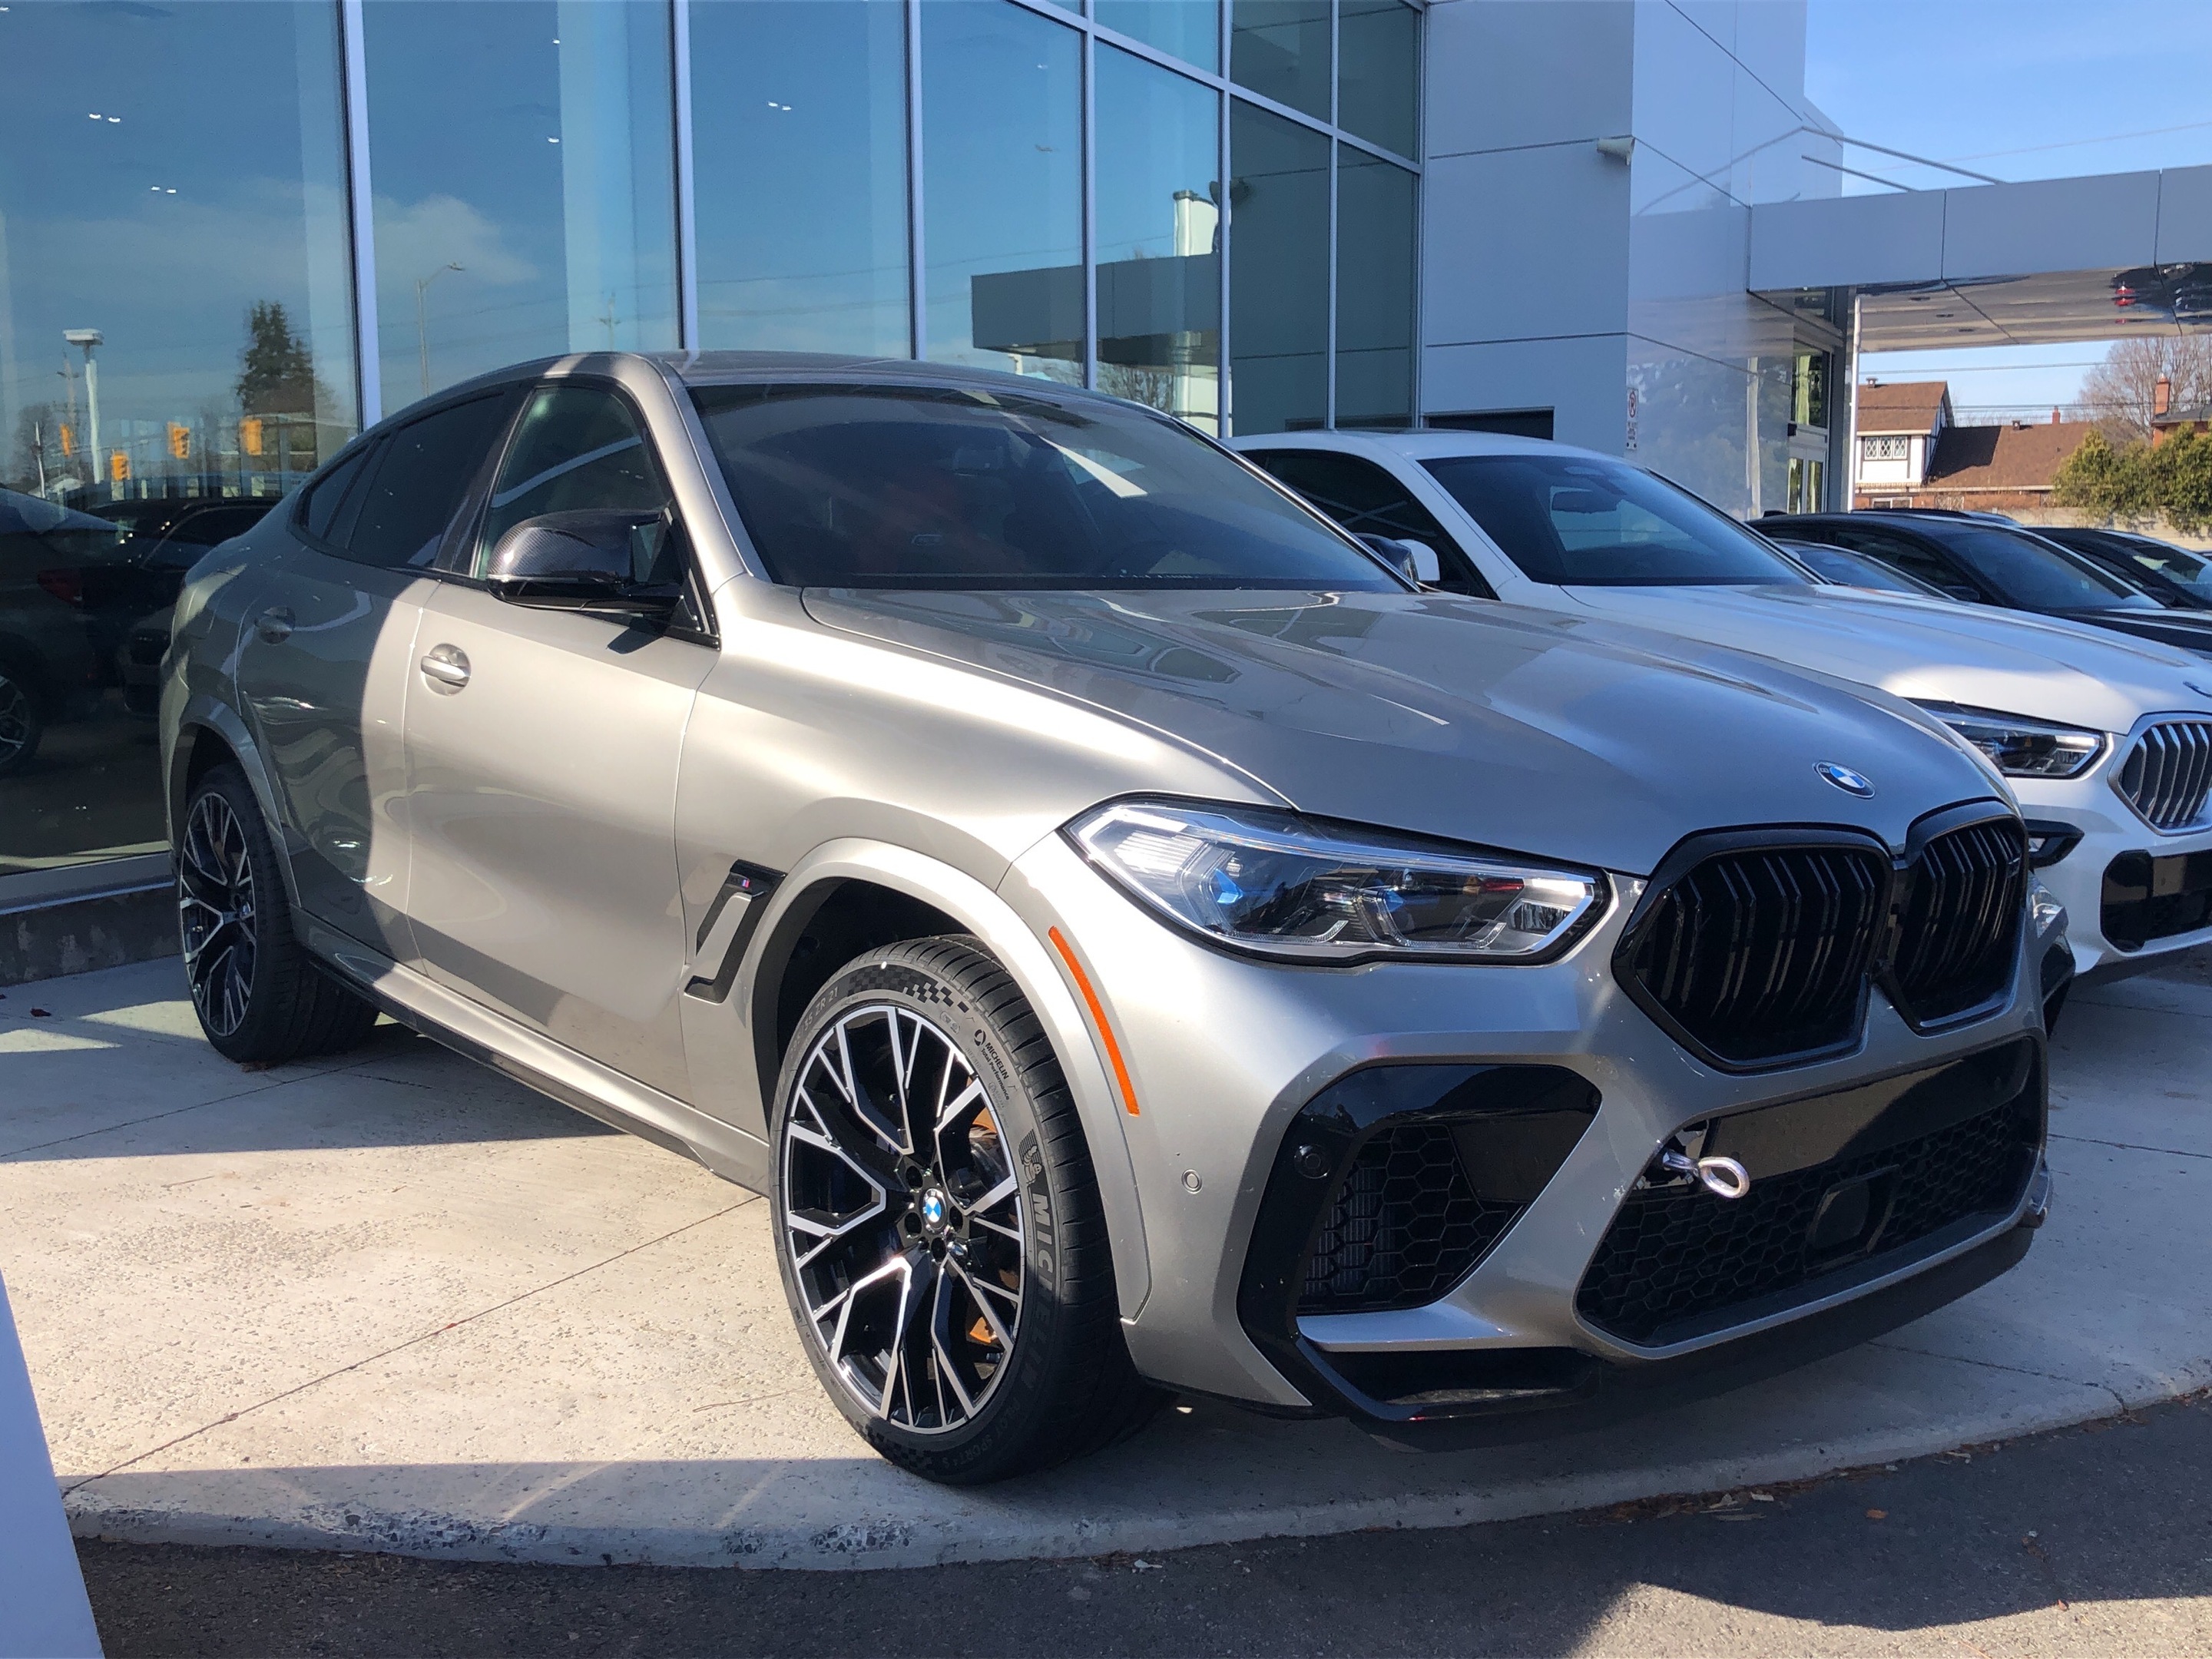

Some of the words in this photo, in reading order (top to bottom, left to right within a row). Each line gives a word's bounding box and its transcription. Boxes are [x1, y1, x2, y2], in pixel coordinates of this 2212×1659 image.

[814, 1000, 826, 1016] ZR
[828, 986, 839, 1002] 21
[981, 1048, 992, 1066] Total
[989, 1061, 1010, 1101] Performance
[985, 1042, 1009, 1080] MICHELIN
[1021, 1193, 1054, 1390] MICHELIN
